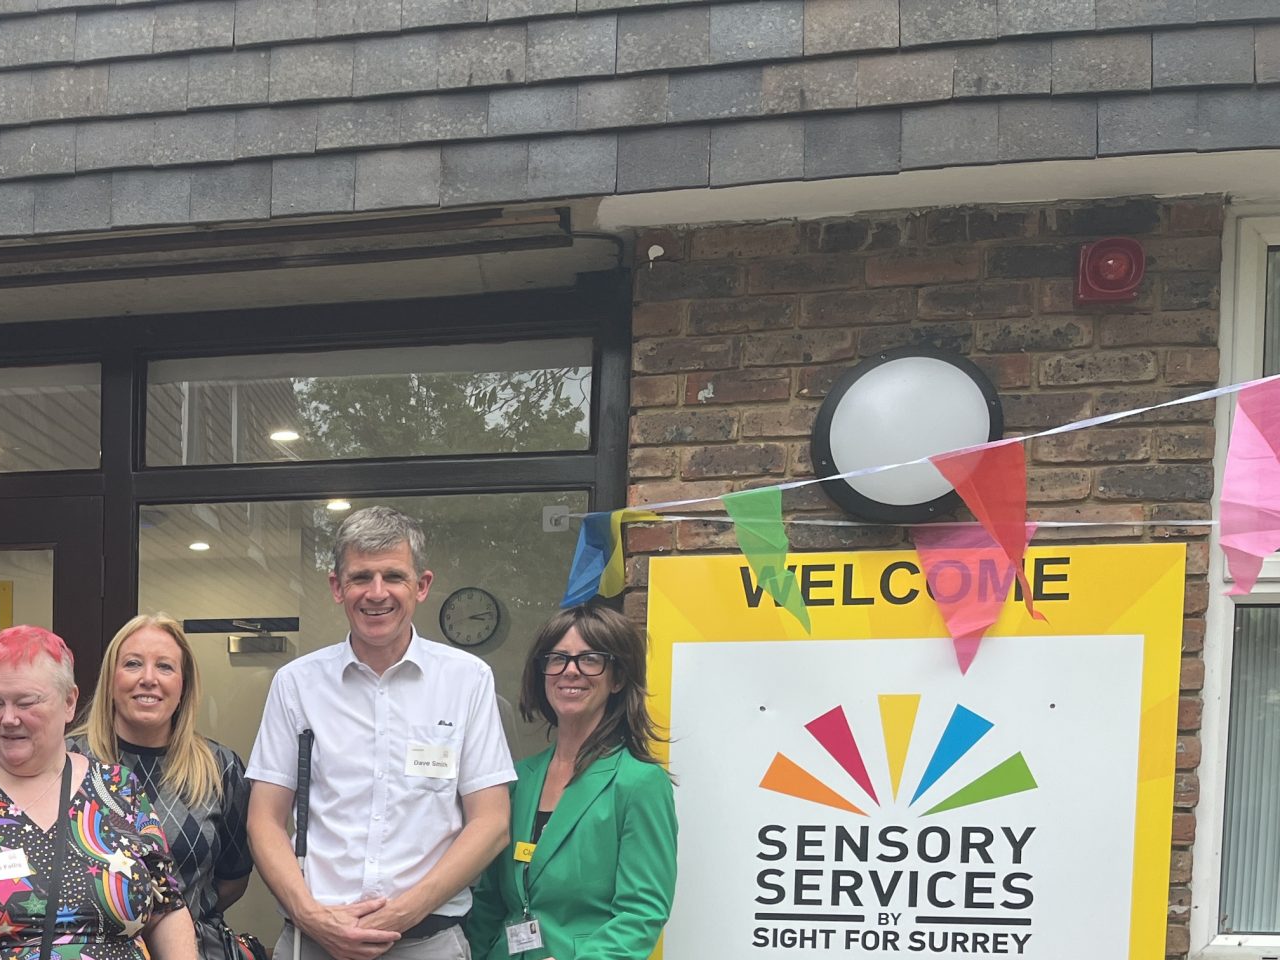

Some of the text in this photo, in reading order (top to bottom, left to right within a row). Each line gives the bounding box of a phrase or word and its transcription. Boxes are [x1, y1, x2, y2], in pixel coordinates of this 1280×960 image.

[740, 557, 1070, 608] WELCOME
[413, 759, 430, 767] Dave
[756, 824, 1037, 865] SENSORY
[754, 869, 1034, 910] SERVICES
[877, 912, 902, 926] BY
[751, 927, 1033, 955] SIGHT FOR SURREY
